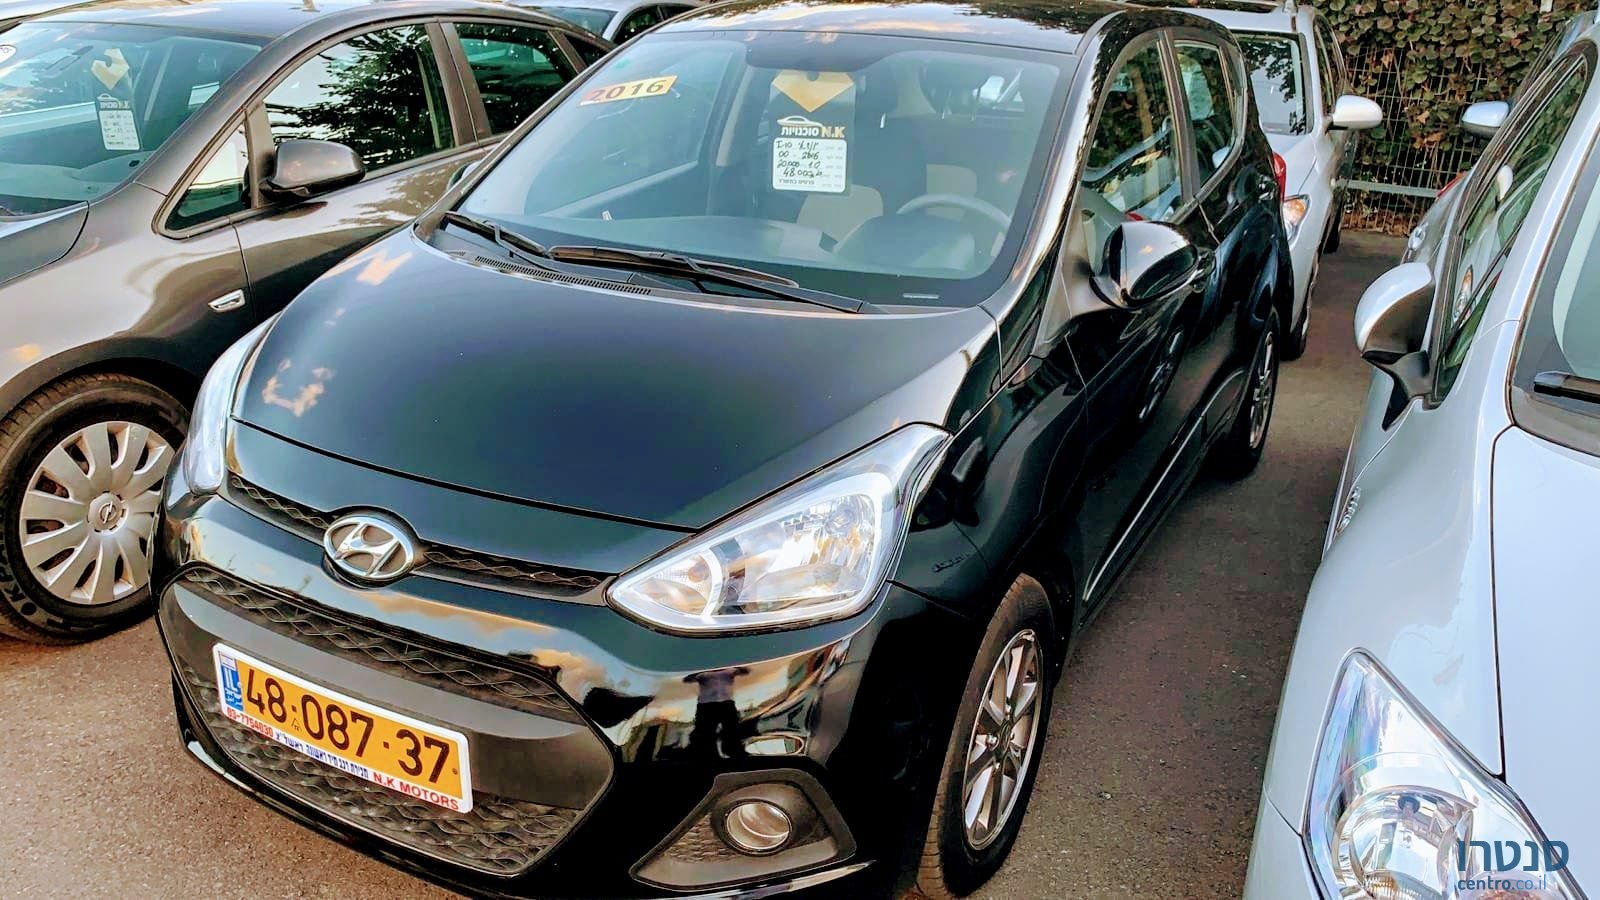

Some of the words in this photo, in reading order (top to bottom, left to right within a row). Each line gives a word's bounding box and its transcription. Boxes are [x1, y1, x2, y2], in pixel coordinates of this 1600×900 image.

[589, 80, 667, 102] 2016
[781, 127, 819, 136] סוכנויות
[821, 126, 846, 138] N.K
[372, 772, 396, 788] N.K
[399, 781, 459, 811] MOTORS
